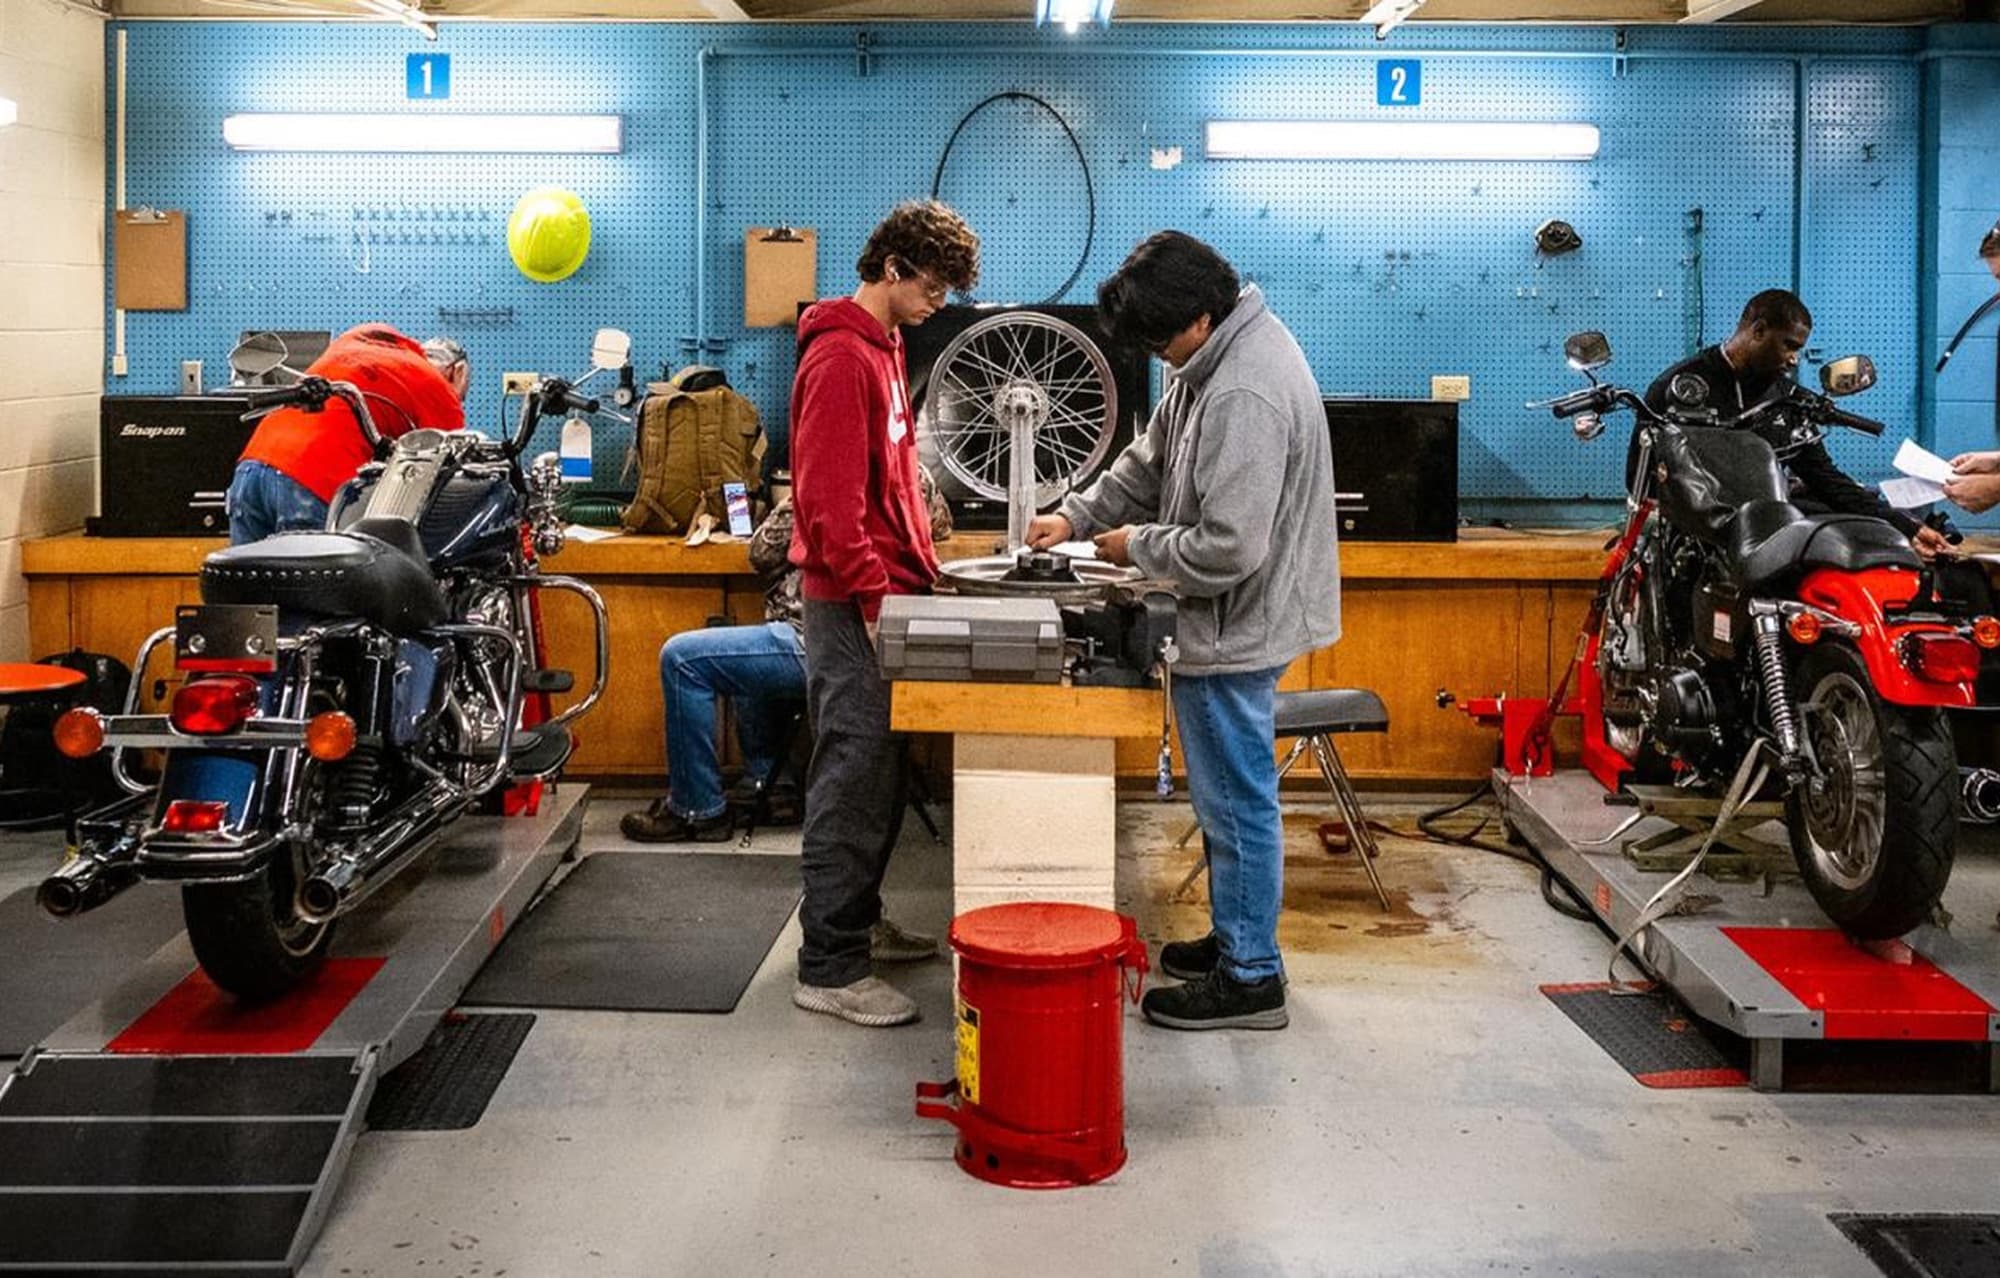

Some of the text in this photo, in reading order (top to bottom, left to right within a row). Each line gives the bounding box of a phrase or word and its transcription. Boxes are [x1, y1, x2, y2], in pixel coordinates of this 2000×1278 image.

[420, 61, 432, 95] 1
[1391, 67, 1407, 101] 2
[120, 424, 187, 439] Snap-on
